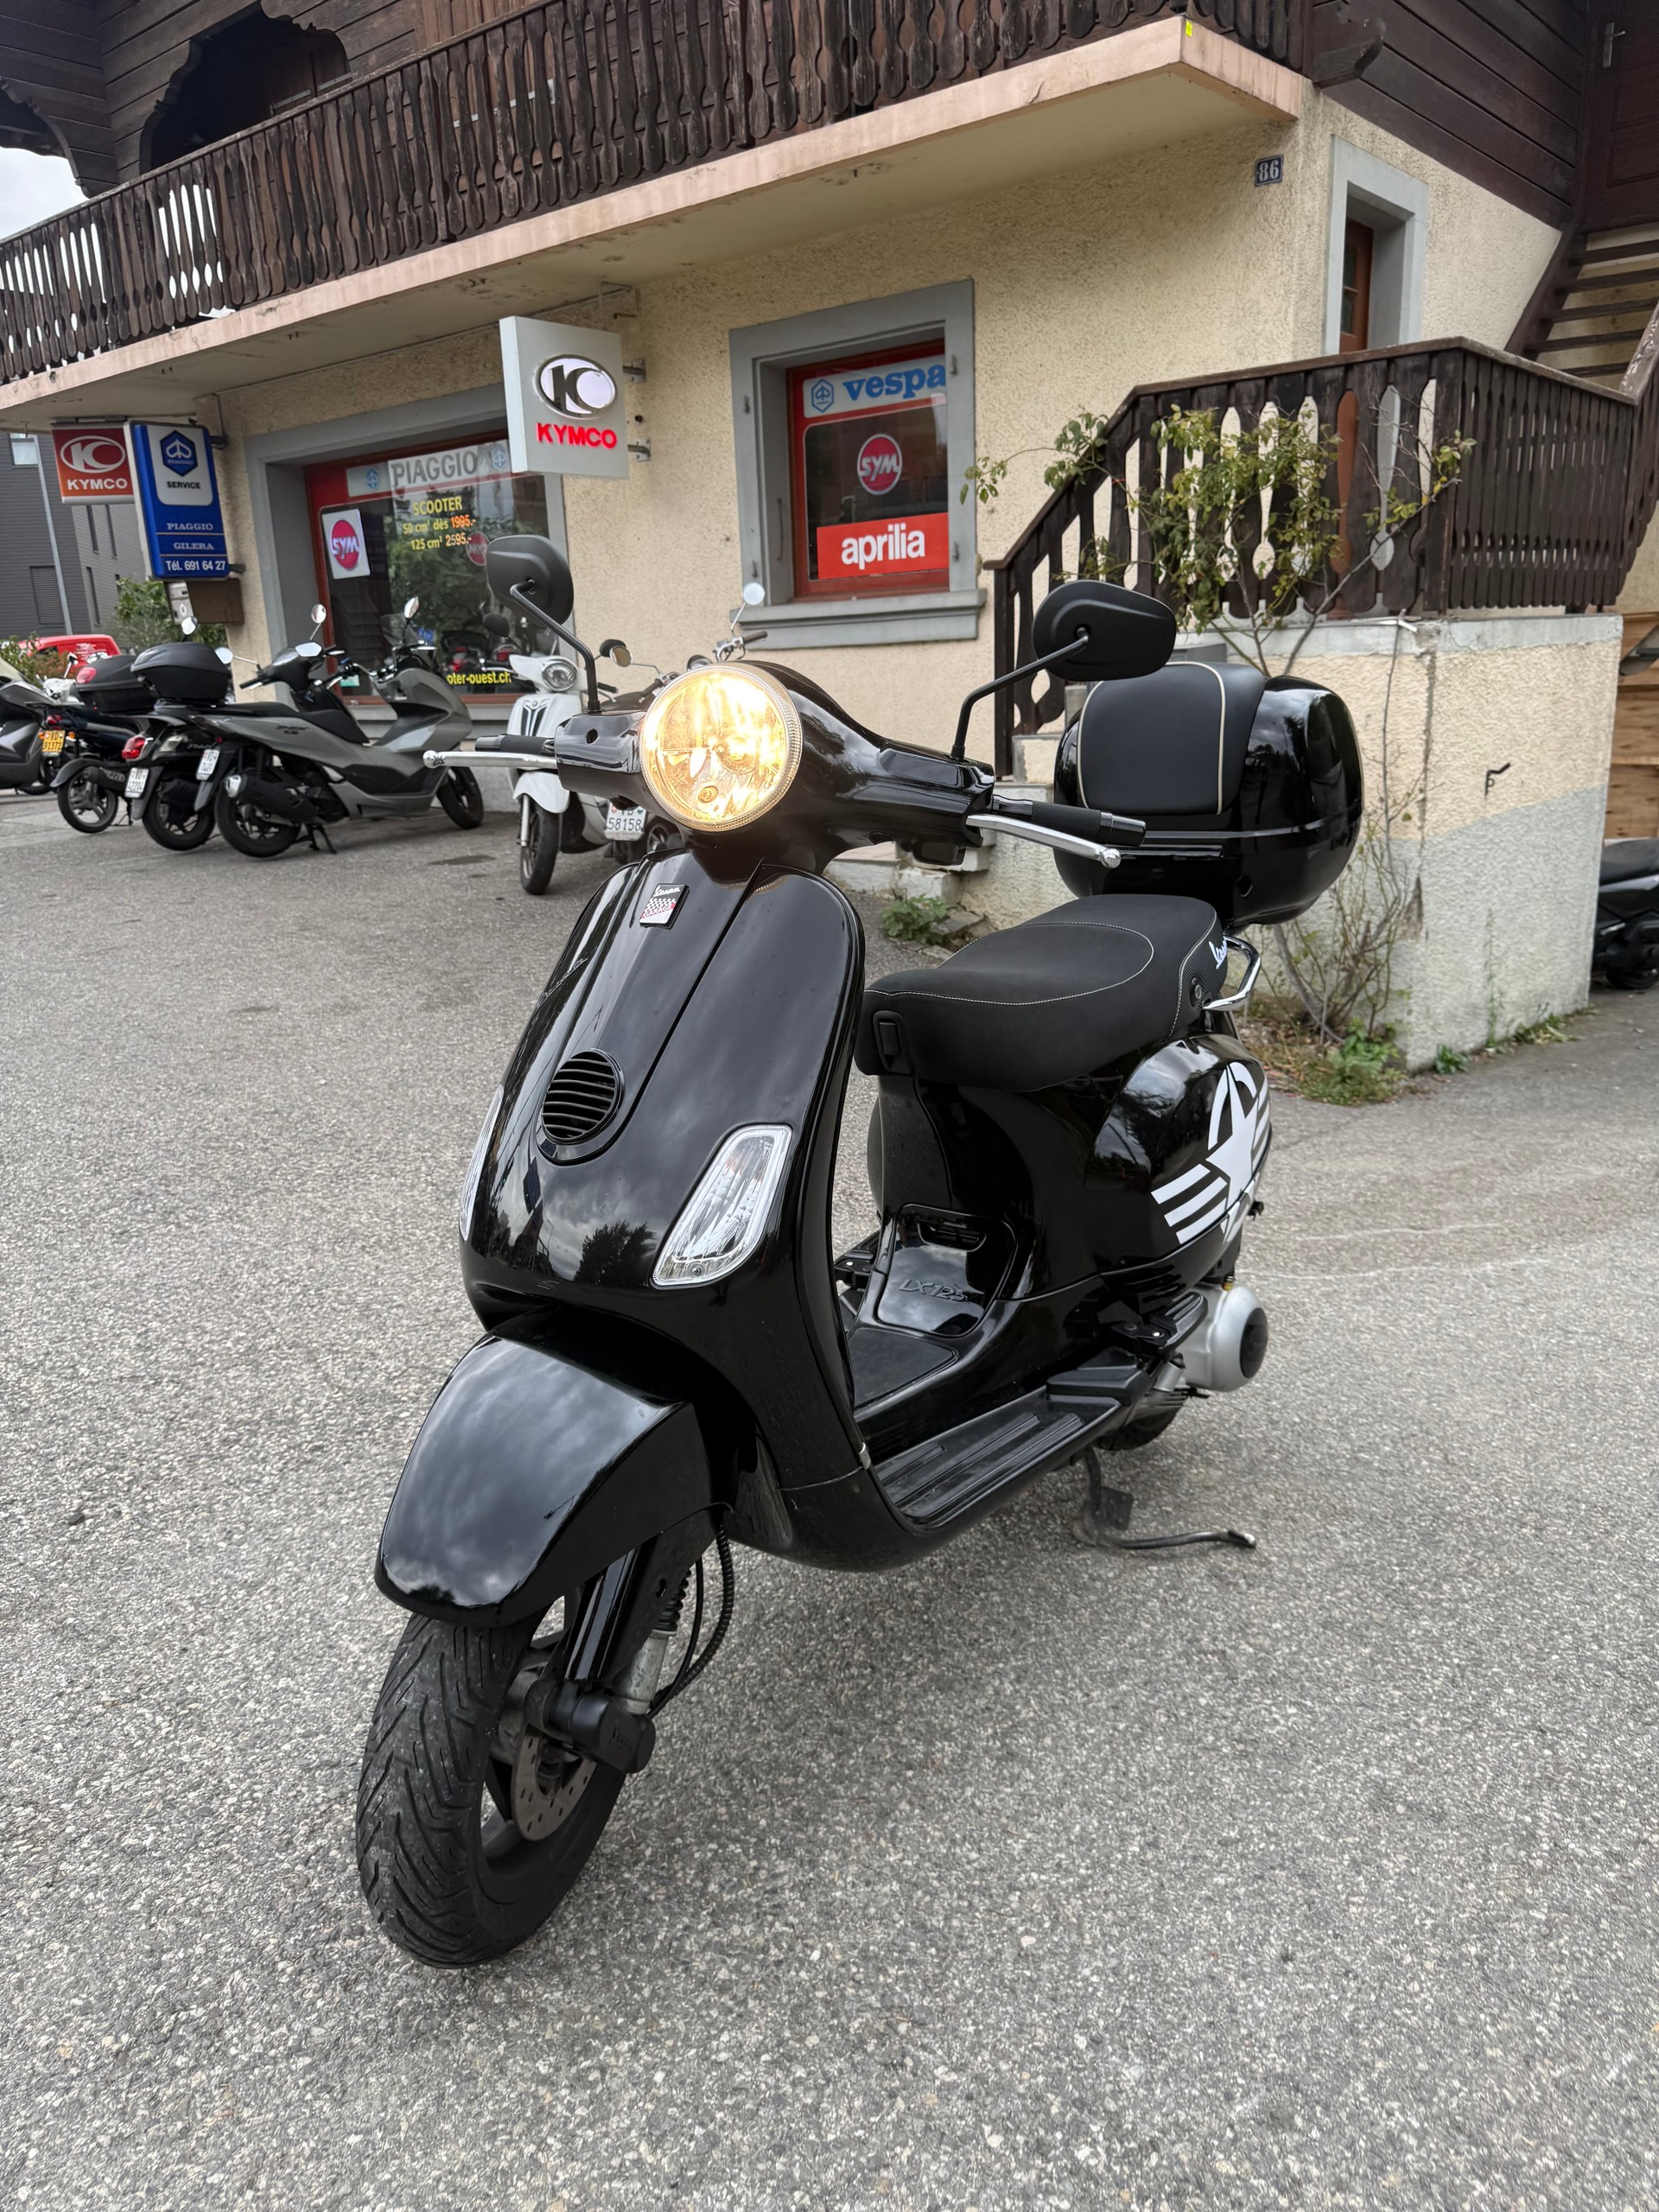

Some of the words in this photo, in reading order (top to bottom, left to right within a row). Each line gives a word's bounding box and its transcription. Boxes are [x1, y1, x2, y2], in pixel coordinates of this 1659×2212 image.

[1258, 160, 1280, 181] 86
[842, 364, 946, 401] vespa
[536, 422, 617, 449] KYMCO
[391, 449, 478, 486] PIAGGIO
[859, 454, 900, 481] SYM
[67, 478, 128, 491] KYMCO
[166, 480, 201, 490] SERVICE
[412, 496, 463, 516] SCOOTER
[166, 523, 213, 531] PIAGGIO
[403, 522, 413, 535] 50
[433, 518, 448, 531] dès
[450, 514, 476, 529] 1995.-
[173, 542, 214, 550] GILERA
[331, 536, 359, 561] SYM
[410, 537, 425, 551] 125
[445, 532, 472, 547] 2595.-
[841, 522, 925, 570] aprilia
[165, 560, 182, 571] Tél.
[184, 560, 200, 571] 691
[202, 560, 213, 571] 64
[215, 560, 226, 571] 27
[447, 671, 512, 685] oter-ouest.ch
[607, 817, 641, 831] 58158
